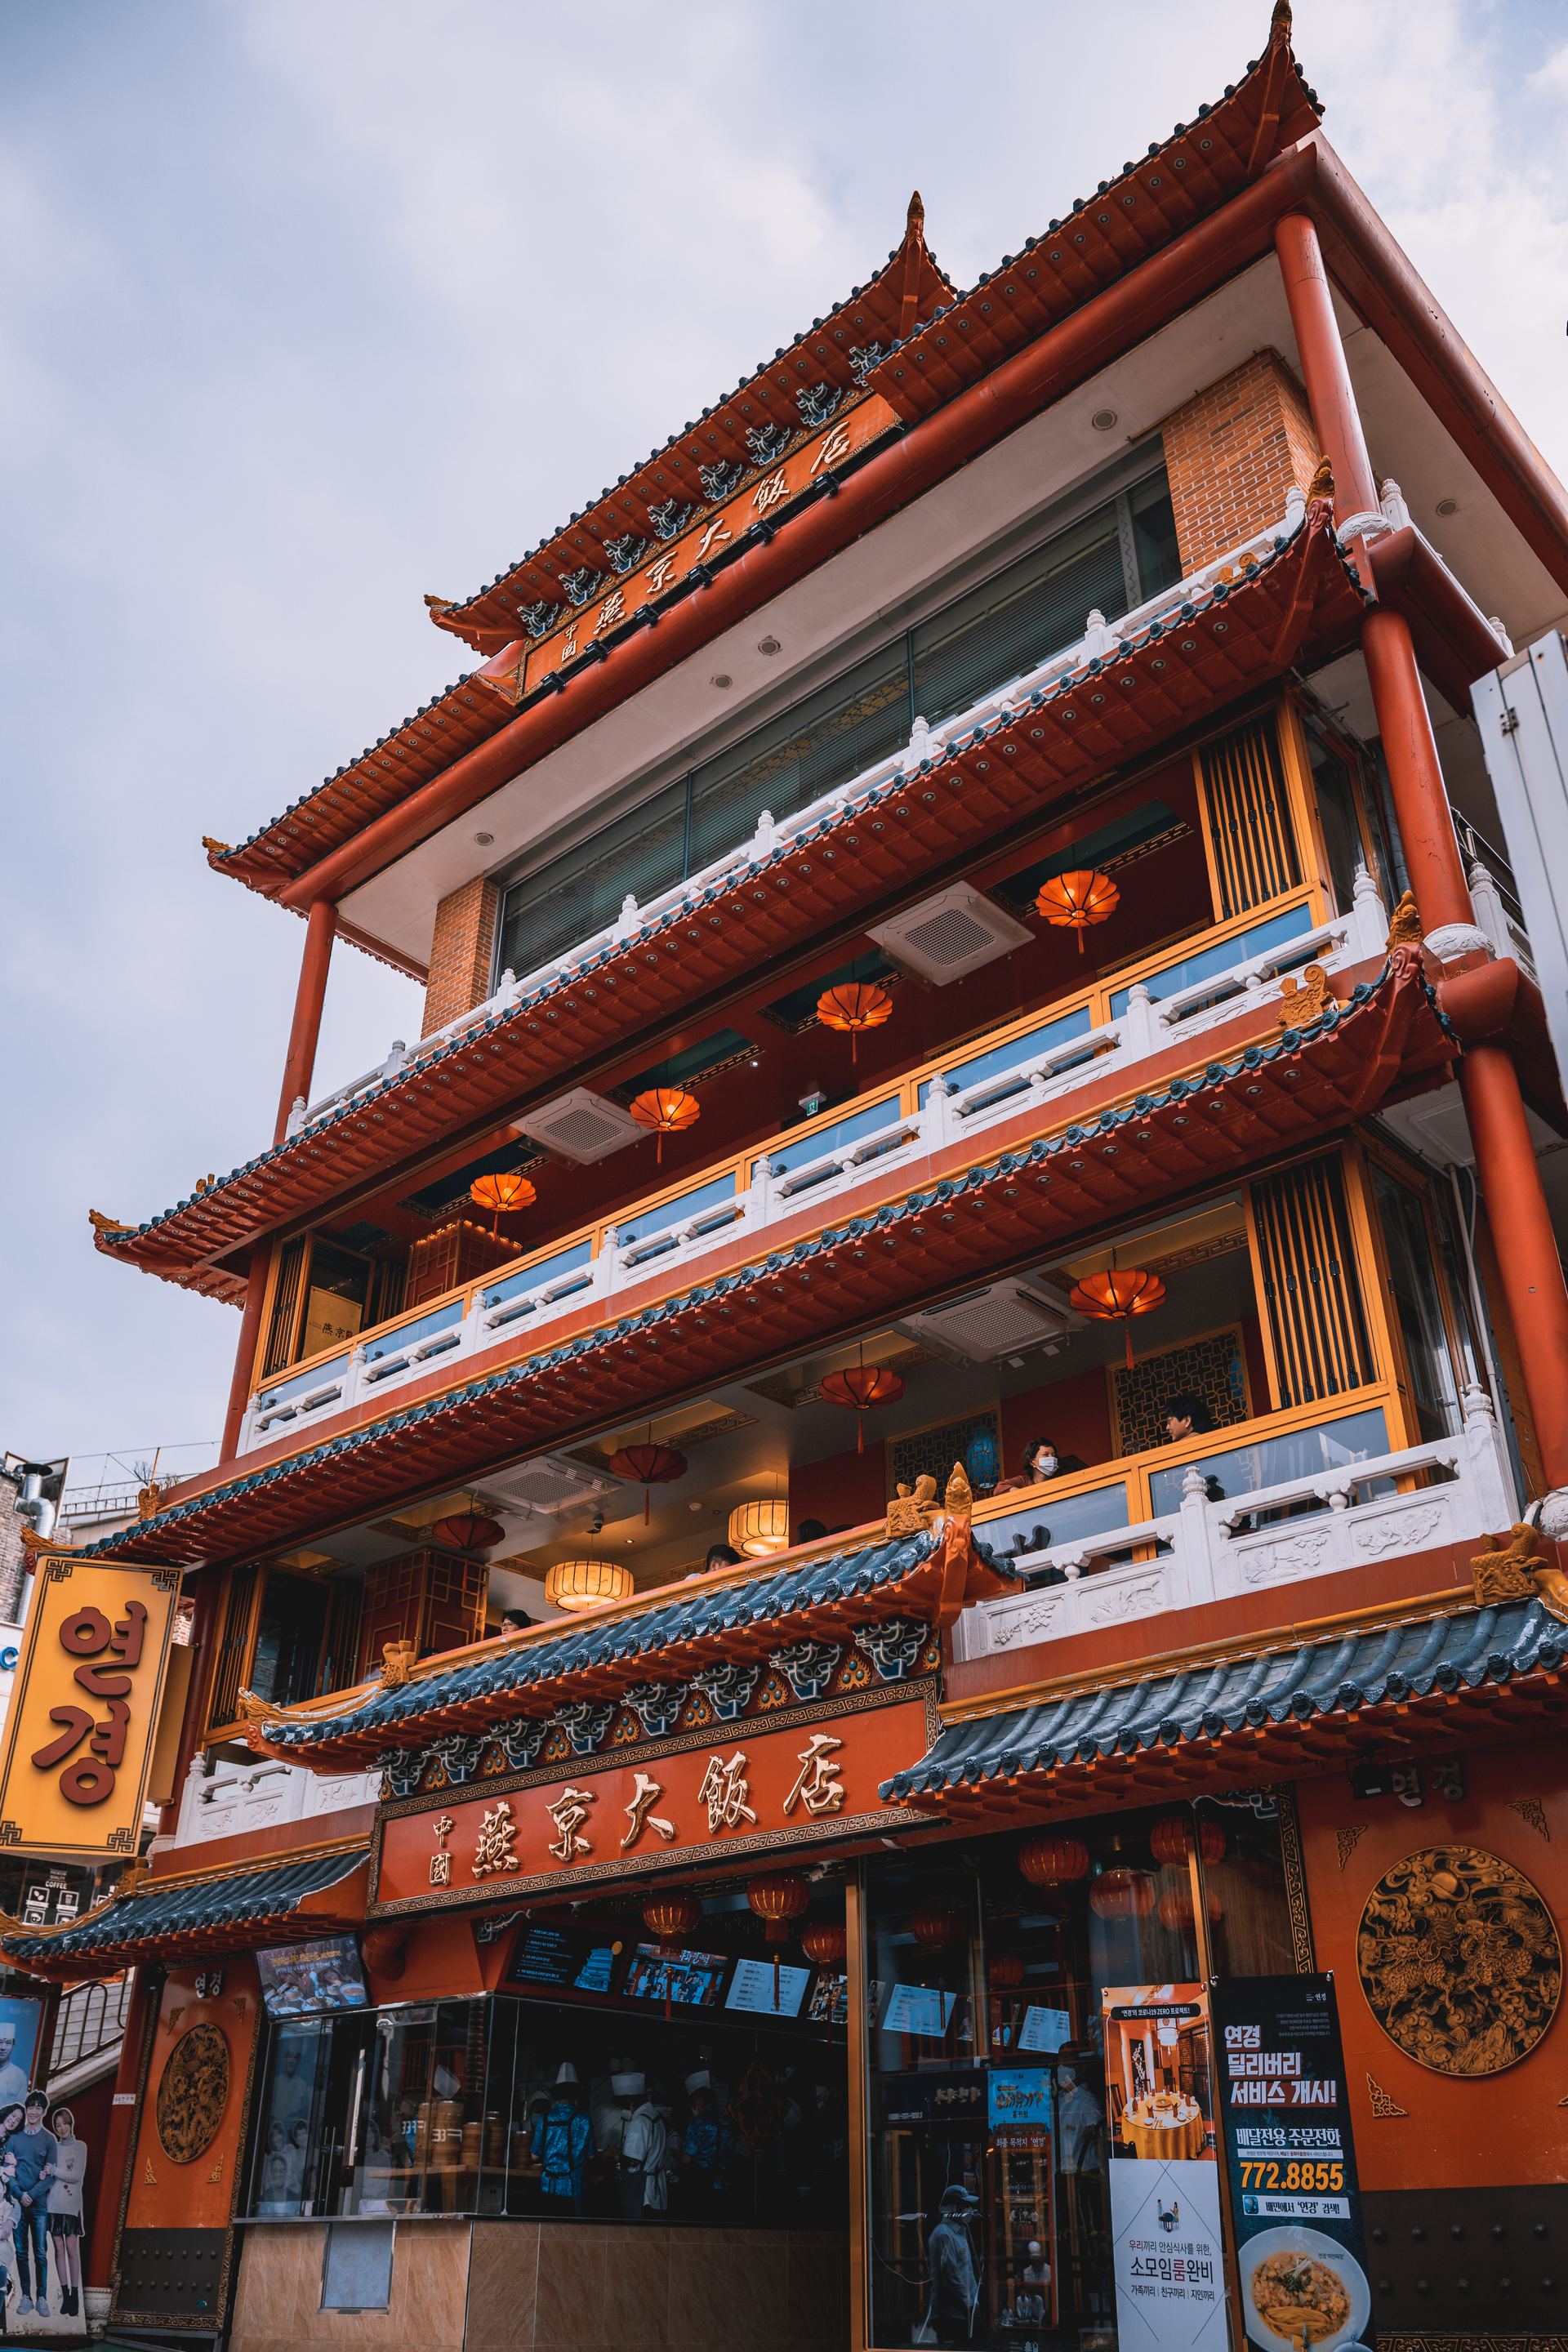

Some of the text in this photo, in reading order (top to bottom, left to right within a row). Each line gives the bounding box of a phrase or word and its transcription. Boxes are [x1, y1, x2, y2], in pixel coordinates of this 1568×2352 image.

[322, 1322, 345, 1339] 燕京
[31, 1601, 148, 1806] 연경
[1392, 1760, 1464, 1807] 연경
[429, 1731, 847, 1886] 中國 燕京大飯店
[45, 1881, 68, 1890] COFFEE
[194, 1970, 222, 1998] 연경
[1315, 1993, 1326, 2001] 연경
[1224, 2025, 1261, 2049] 연경
[1228, 2052, 1302, 2076] 딜리버리
[1231, 2080, 1336, 2105] 서비스 개시!
[996, 2137, 1008, 2148] 최종
[1009, 2137, 1027, 2147] 목적지
[1236, 2128, 1341, 2146] 배달전용 주문전화
[1240, 2162, 1344, 2191] 772.8855
[1266, 2202, 1295, 2213] 배민에서
[1321, 2203, 1340, 2214] 검색!
[1129, 2239, 1212, 2256] 우리끼리 안심식사를 위한,
[1130, 2256, 1214, 2284] 소모임룸완비
[1131, 2284, 1215, 2301] 가족끼리 친구끼리 지인끼리
